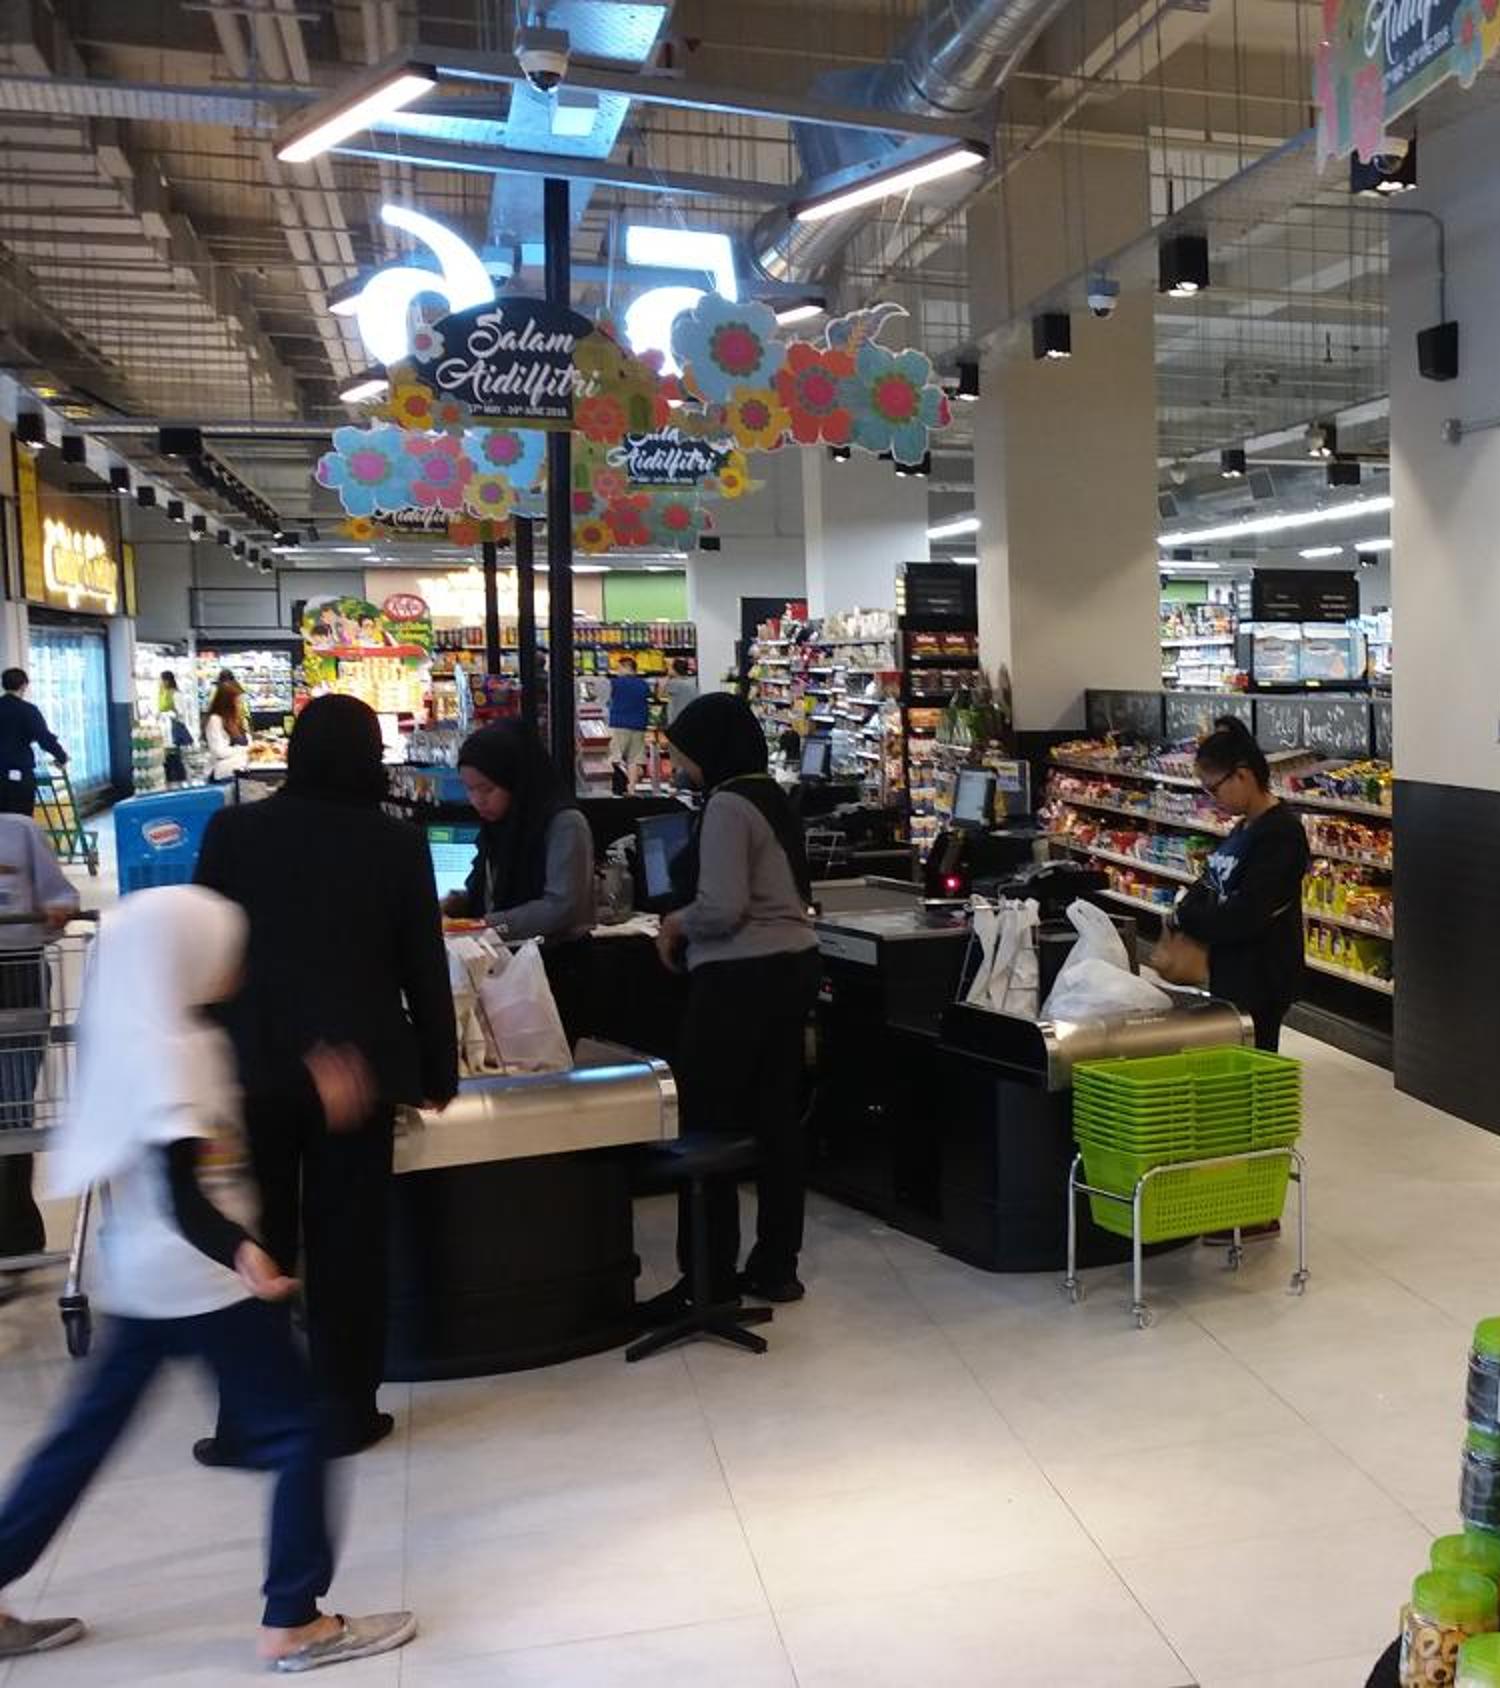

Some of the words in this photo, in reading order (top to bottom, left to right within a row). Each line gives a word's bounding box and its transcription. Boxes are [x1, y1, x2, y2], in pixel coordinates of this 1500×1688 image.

[467, 307, 575, 358] Salam
[435, 357, 600, 407] Aidilfitri
[607, 447, 715, 480] Aidilfitri
